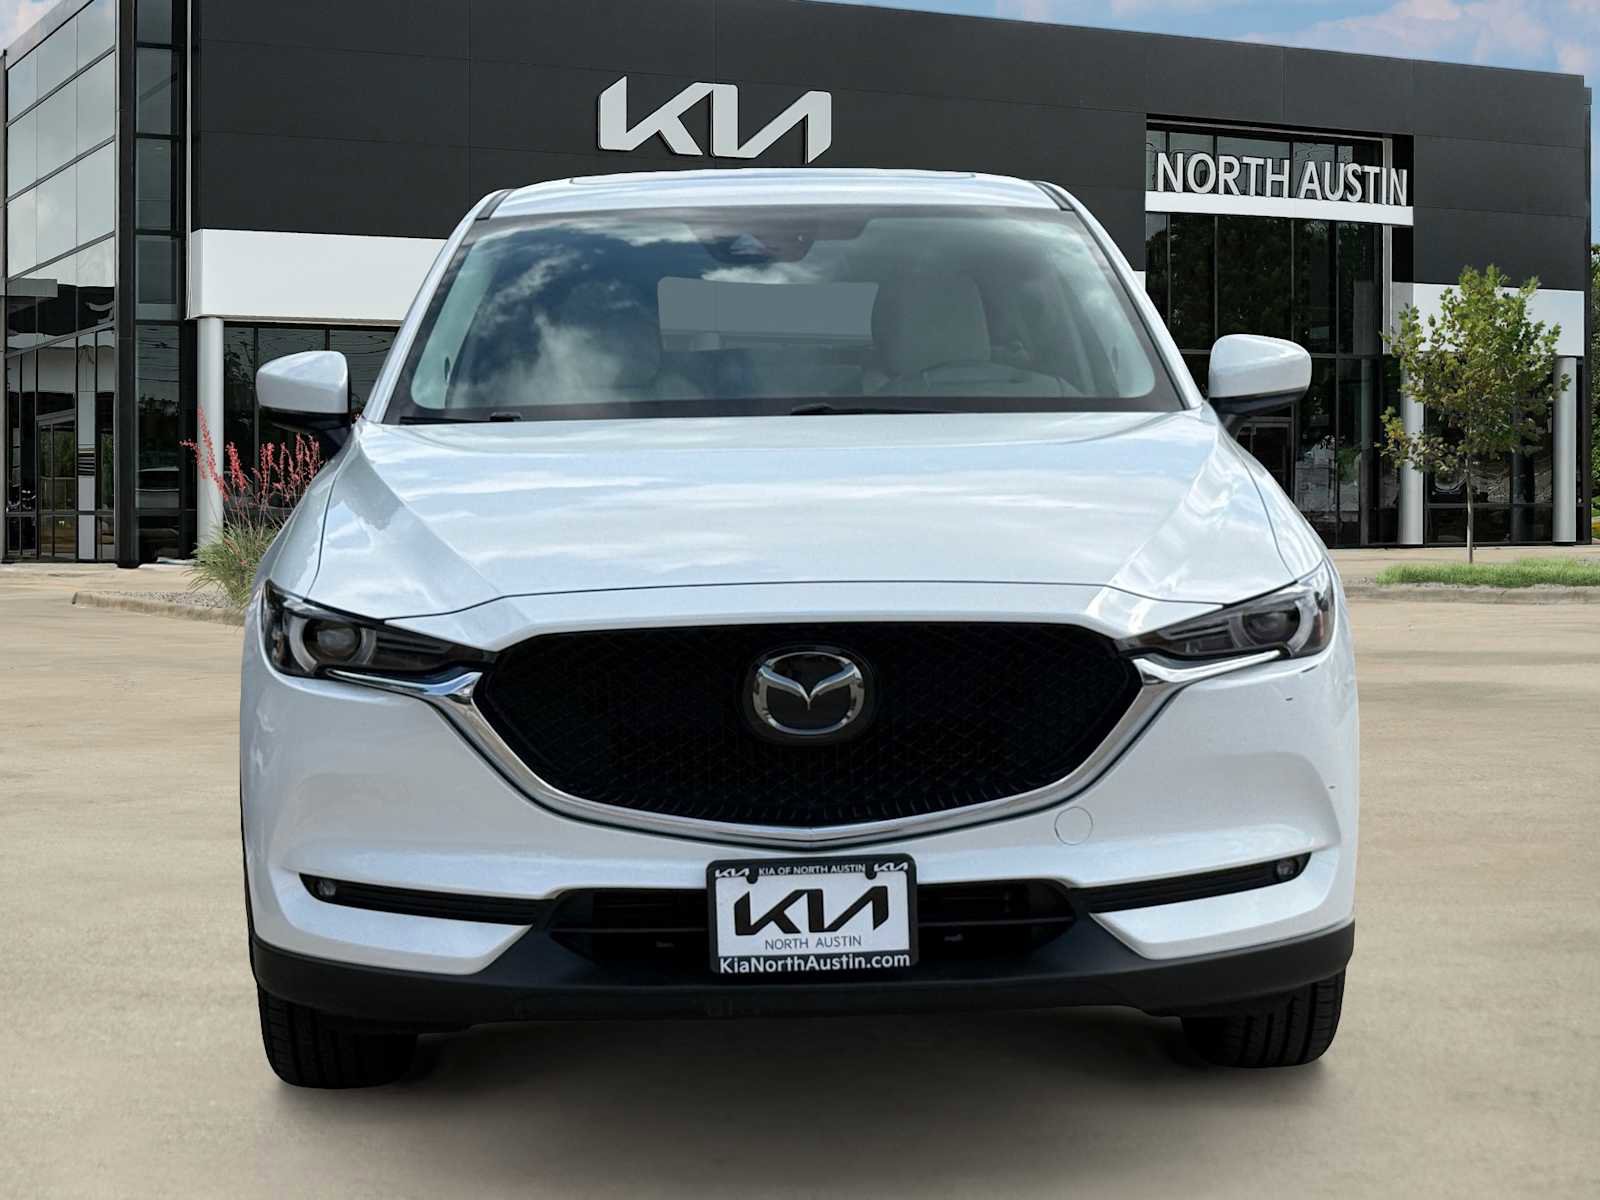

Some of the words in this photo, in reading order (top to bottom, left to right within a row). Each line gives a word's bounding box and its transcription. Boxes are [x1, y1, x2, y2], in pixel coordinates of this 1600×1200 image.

[598, 75, 832, 164] KIA
[1157, 152, 1290, 199] NORTH
[1299, 161, 1407, 206] AUSTIN
[758, 867, 776, 876] KIA
[778, 867, 792, 875] OF
[793, 865, 830, 875] NORTH
[830, 863, 866, 873] AUSTIN
[734, 885, 889, 936] KIA
[765, 938, 808, 950] NORTH
[815, 935, 862, 948] AUSTIN
[720, 953, 910, 974] KiaNorthAustin.com
